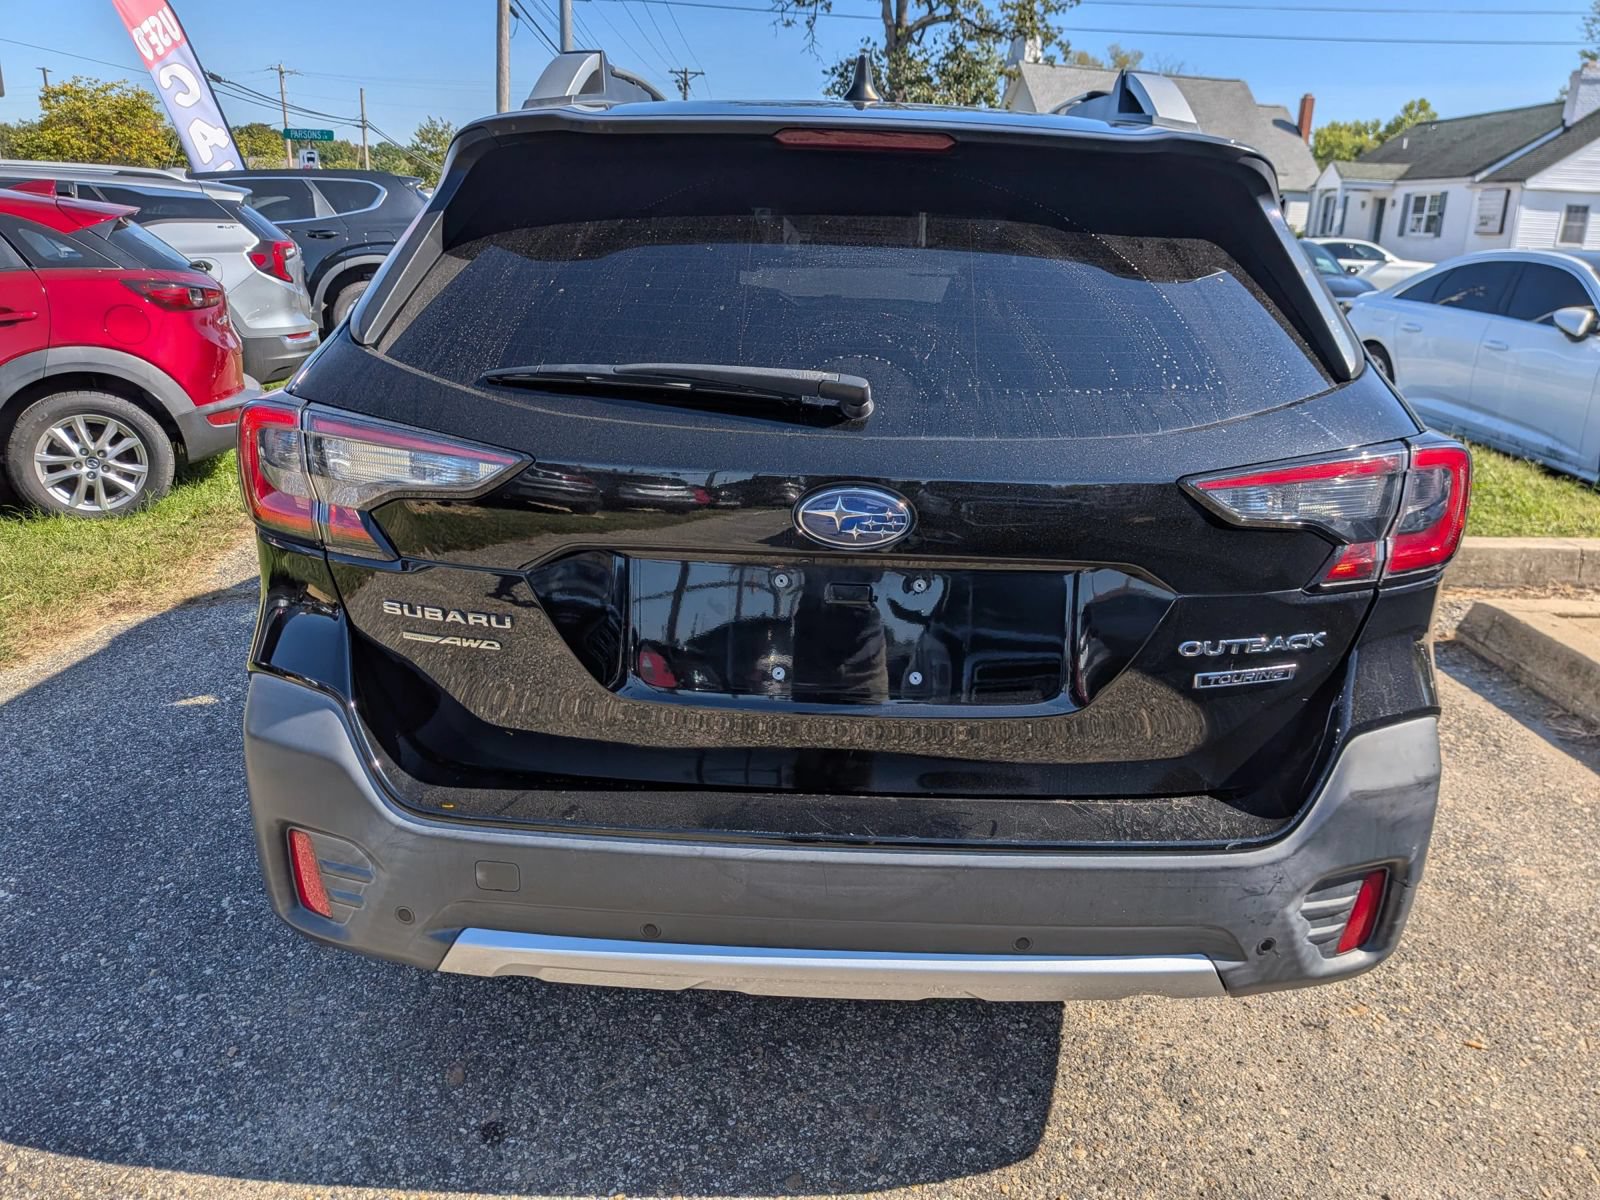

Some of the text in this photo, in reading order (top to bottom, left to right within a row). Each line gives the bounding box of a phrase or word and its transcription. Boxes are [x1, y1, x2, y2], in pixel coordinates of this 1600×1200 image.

[290, 129, 322, 139] PARSONS
[382, 600, 512, 629] SUBARU
[439, 636, 502, 651] AWD
[1177, 631, 1327, 657] OUTBACK
[1208, 669, 1285, 685] TOURING
